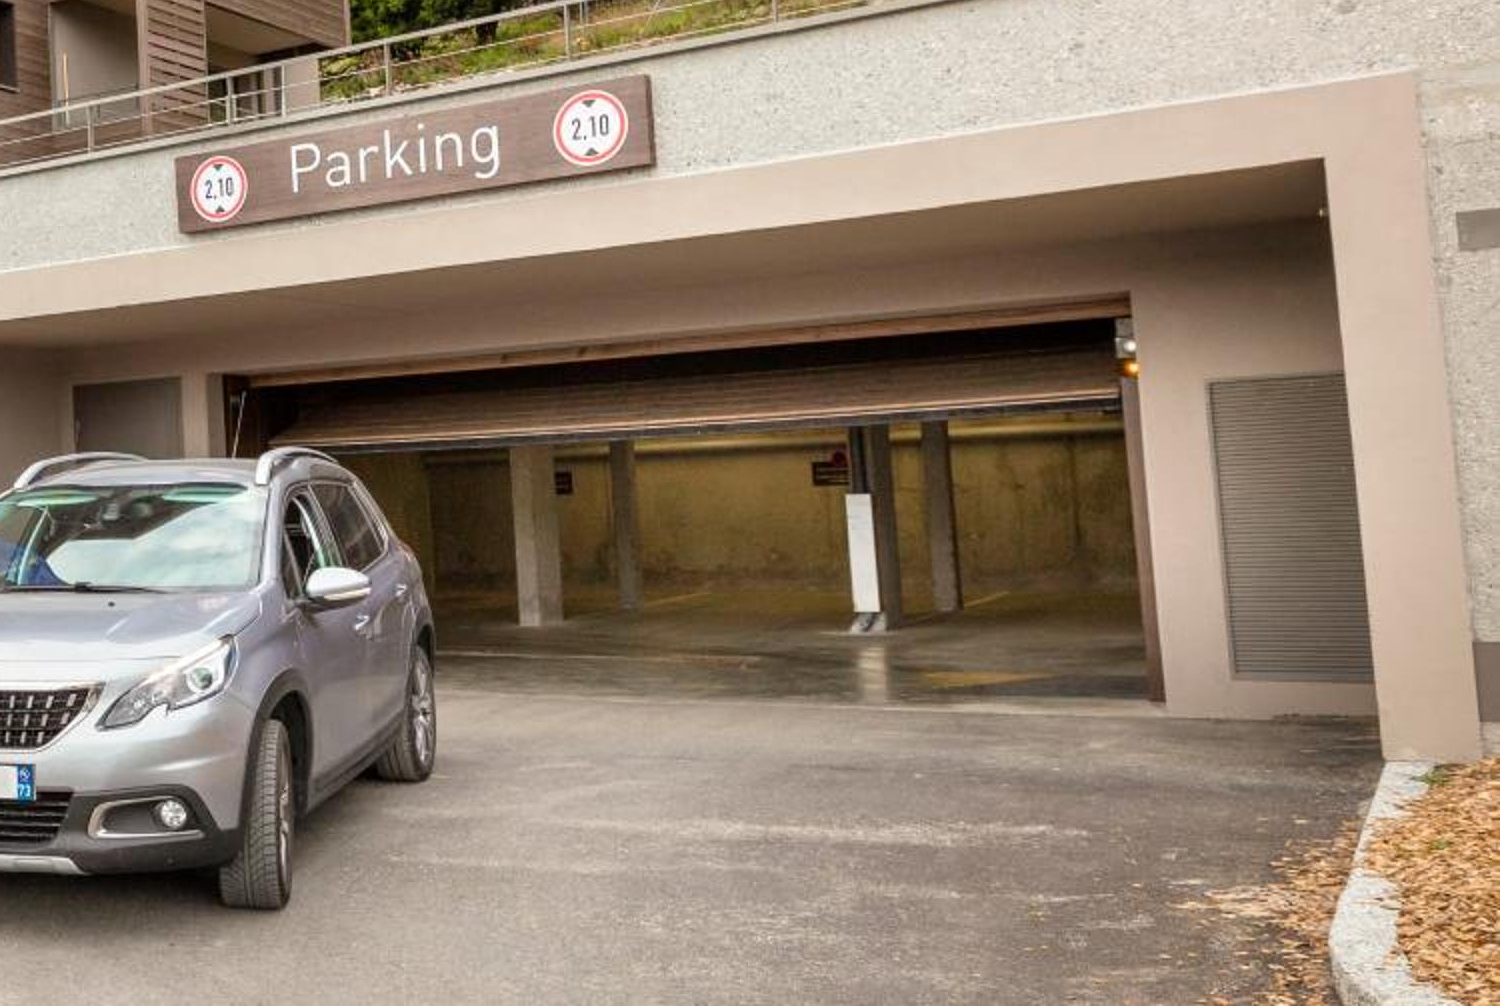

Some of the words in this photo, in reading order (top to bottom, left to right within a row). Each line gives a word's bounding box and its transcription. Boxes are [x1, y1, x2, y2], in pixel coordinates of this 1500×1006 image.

[205, 177, 234, 200] 2.10
[289, 123, 500, 193] Parking
[571, 113, 610, 141] 2.10
